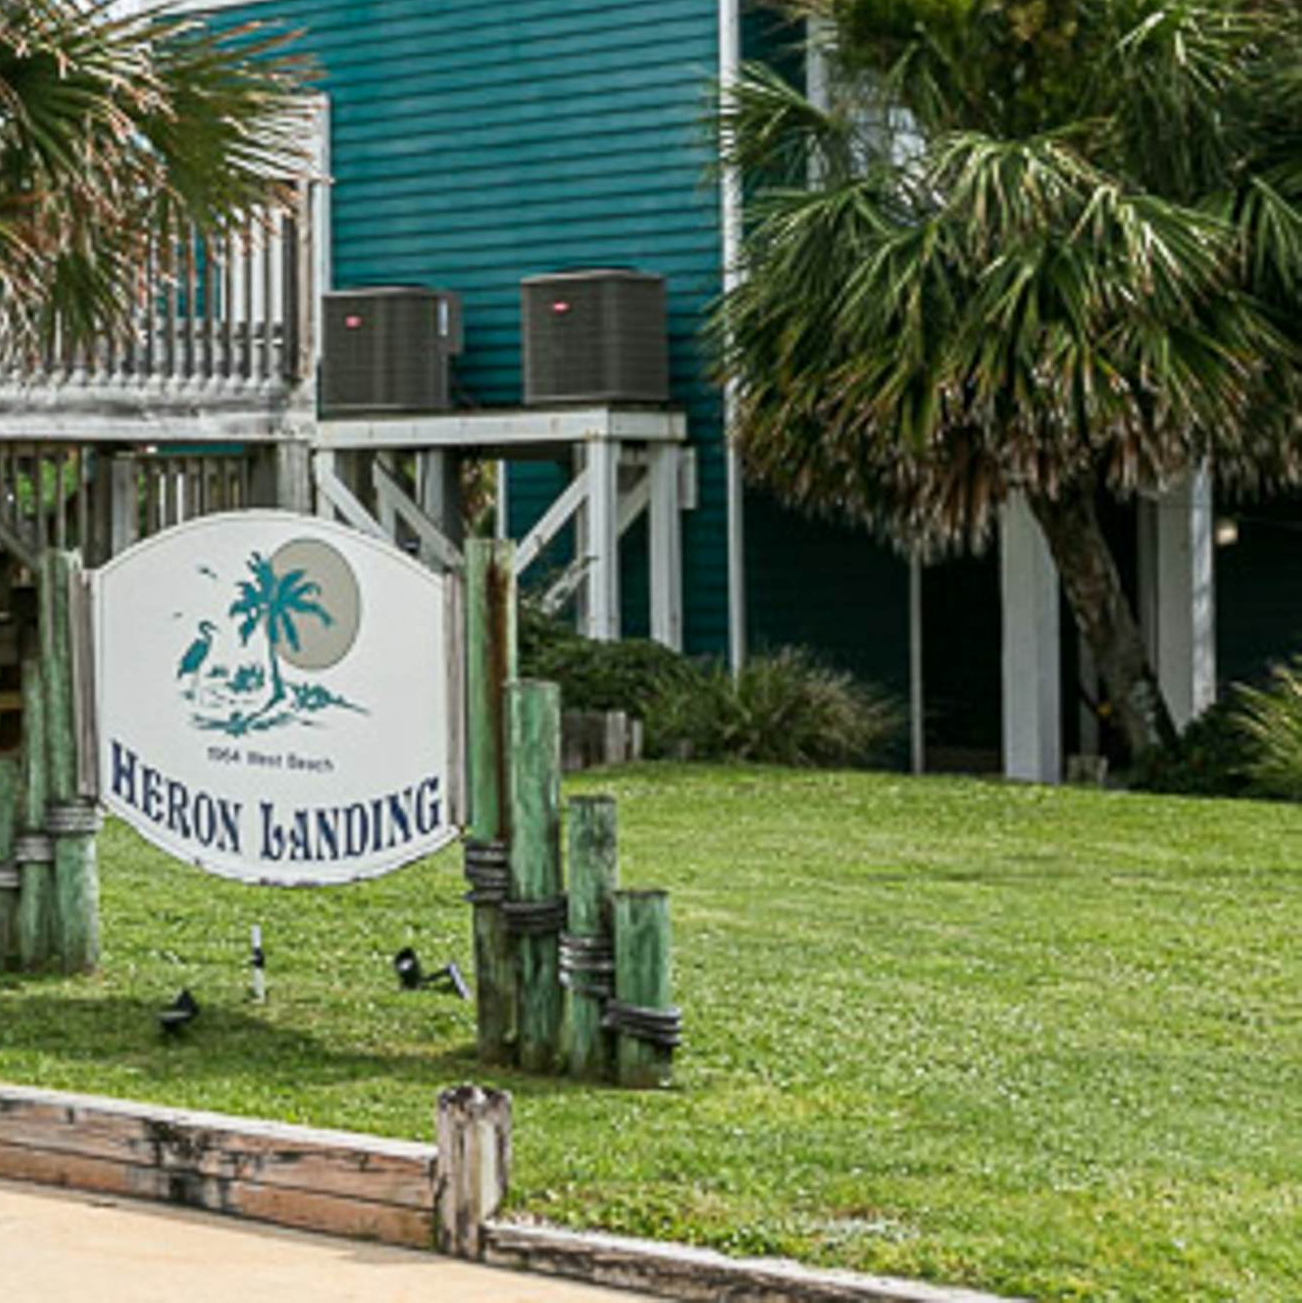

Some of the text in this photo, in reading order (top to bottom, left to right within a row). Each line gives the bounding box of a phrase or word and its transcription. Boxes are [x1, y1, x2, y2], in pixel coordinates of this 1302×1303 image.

[246, 750, 282, 769] West
[287, 751, 335, 773] Beach
[111, 738, 441, 861] HERON LANDING
